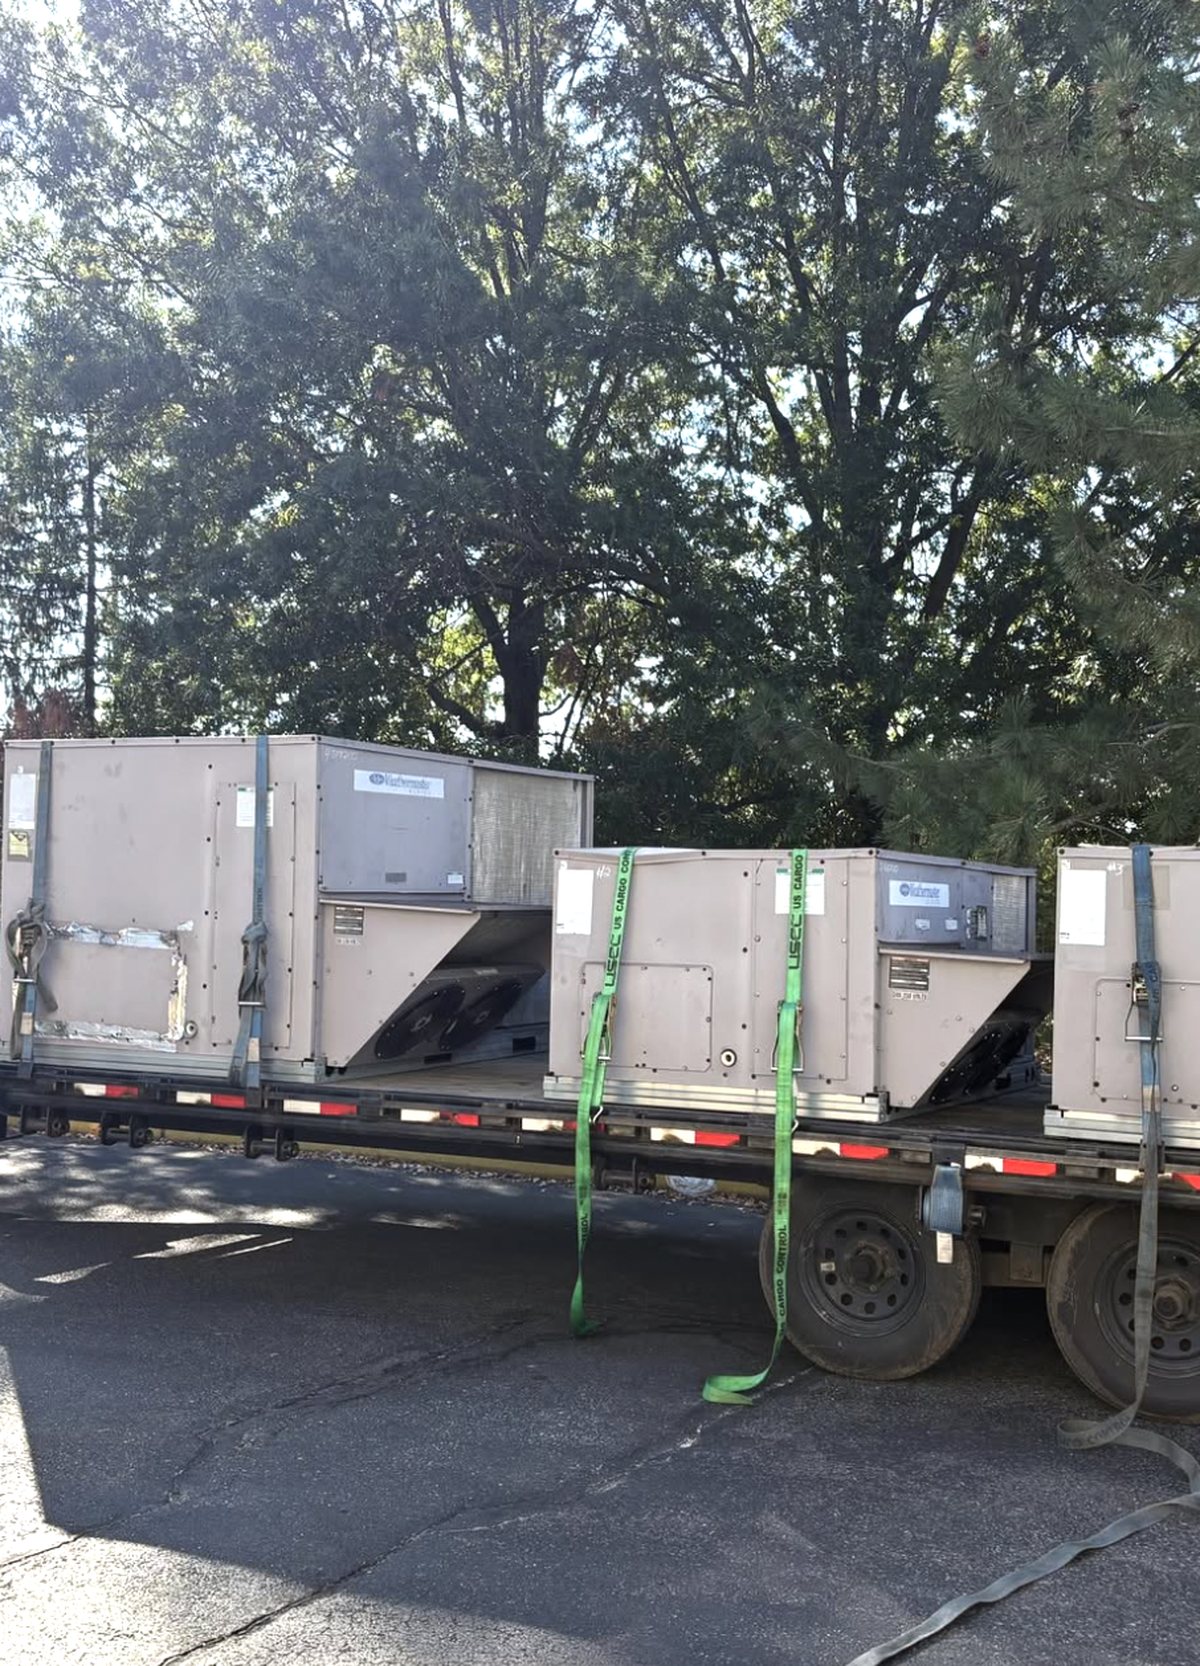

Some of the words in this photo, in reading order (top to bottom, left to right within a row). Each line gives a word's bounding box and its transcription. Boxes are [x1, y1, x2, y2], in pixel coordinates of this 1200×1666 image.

[794, 855, 803, 890] CARGO
[616, 878, 627, 912] CARGO
[793, 895, 801, 909] US
[614, 916, 622, 930] US
[776, 1224, 788, 1274] CONTROL
[776, 1279, 786, 1317] CARGO
